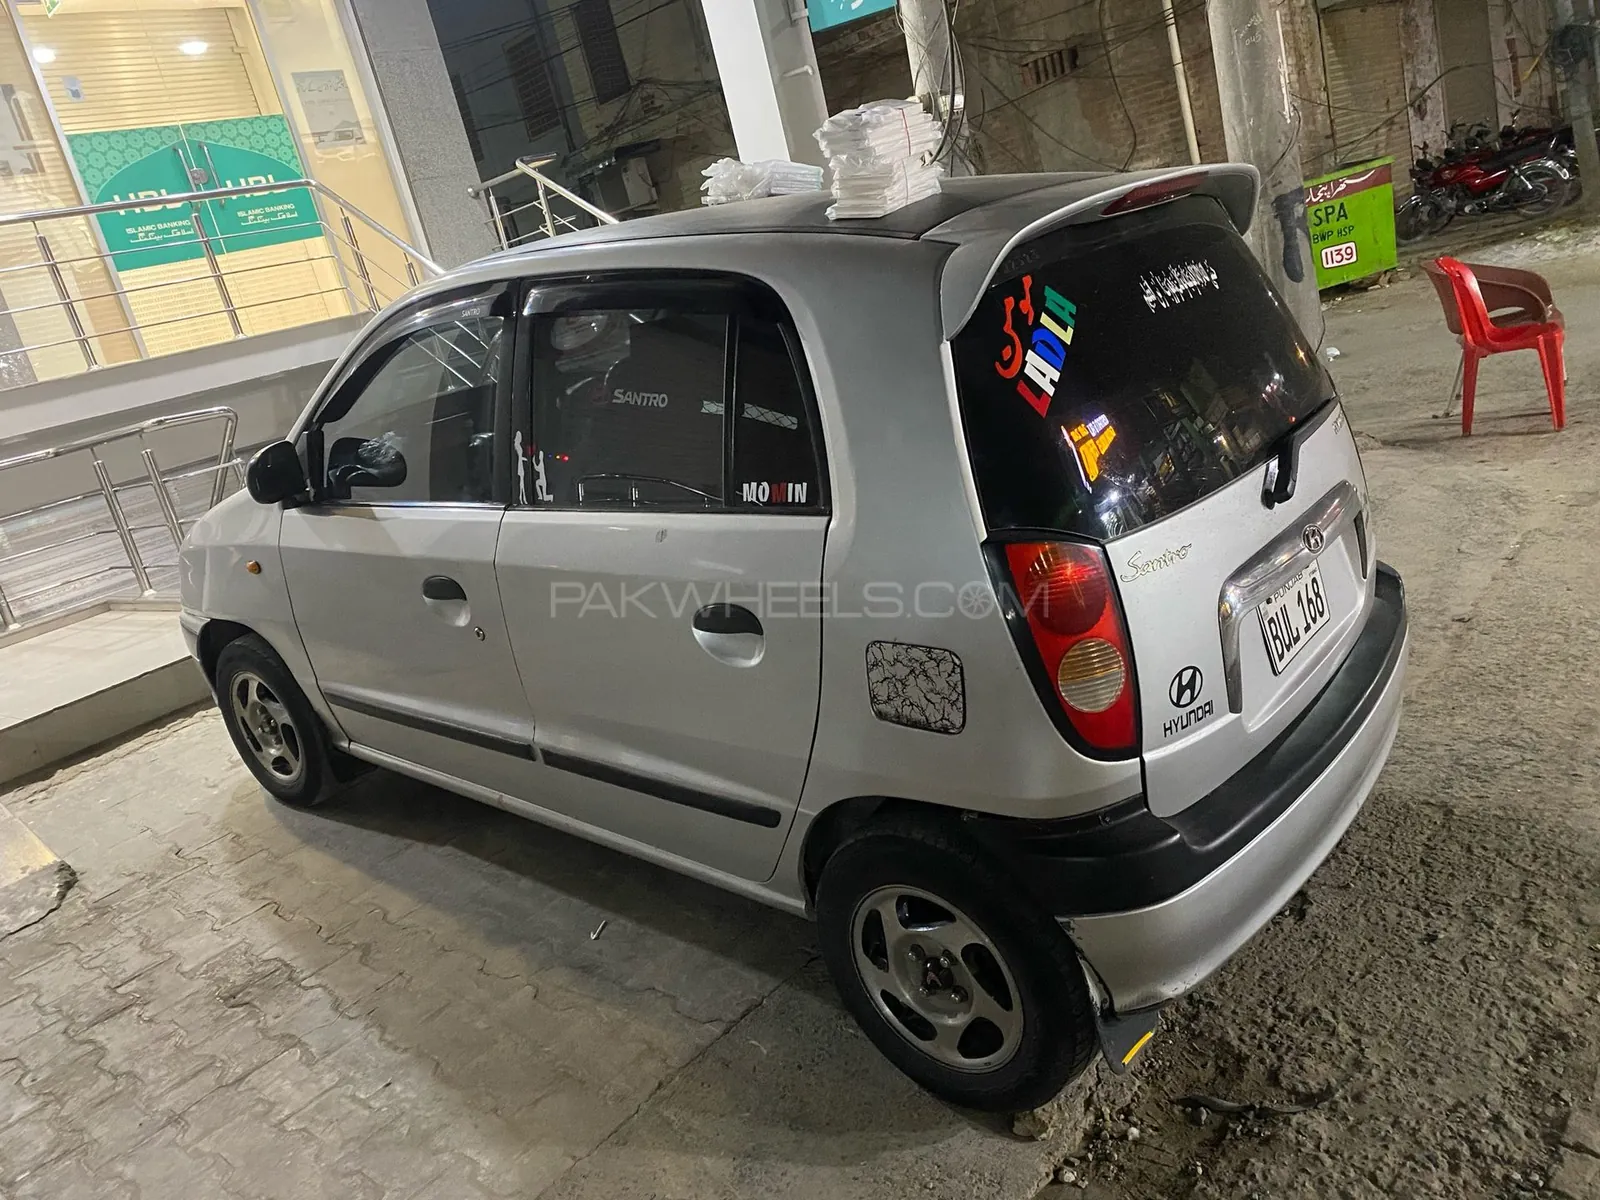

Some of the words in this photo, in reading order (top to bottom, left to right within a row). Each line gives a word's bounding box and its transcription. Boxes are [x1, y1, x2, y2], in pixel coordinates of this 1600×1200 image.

[236, 207, 265, 218] ISLAMIC
[265, 203, 295, 213] BANKING
[1313, 202, 1349, 227] SPA
[125, 225, 157, 234] ISLAMIC
[156, 219, 191, 231] BANKING
[1312, 230, 1334, 245] BWP
[1337, 225, 1355, 238] HSP
[1324, 245, 1354, 266] 1139
[461, 308, 481, 318] SANTRO
[1016, 285, 1077, 420] LADLA
[612, 388, 669, 408] SANTRO
[742, 481, 808, 504] MOMIN
[1120, 543, 1193, 583] Santro
[1273, 571, 1304, 603] PUNJAB
[1266, 603, 1301, 663] BUL
[1296, 576, 1325, 635] 168
[1163, 699, 1214, 738] HYUNDAI
